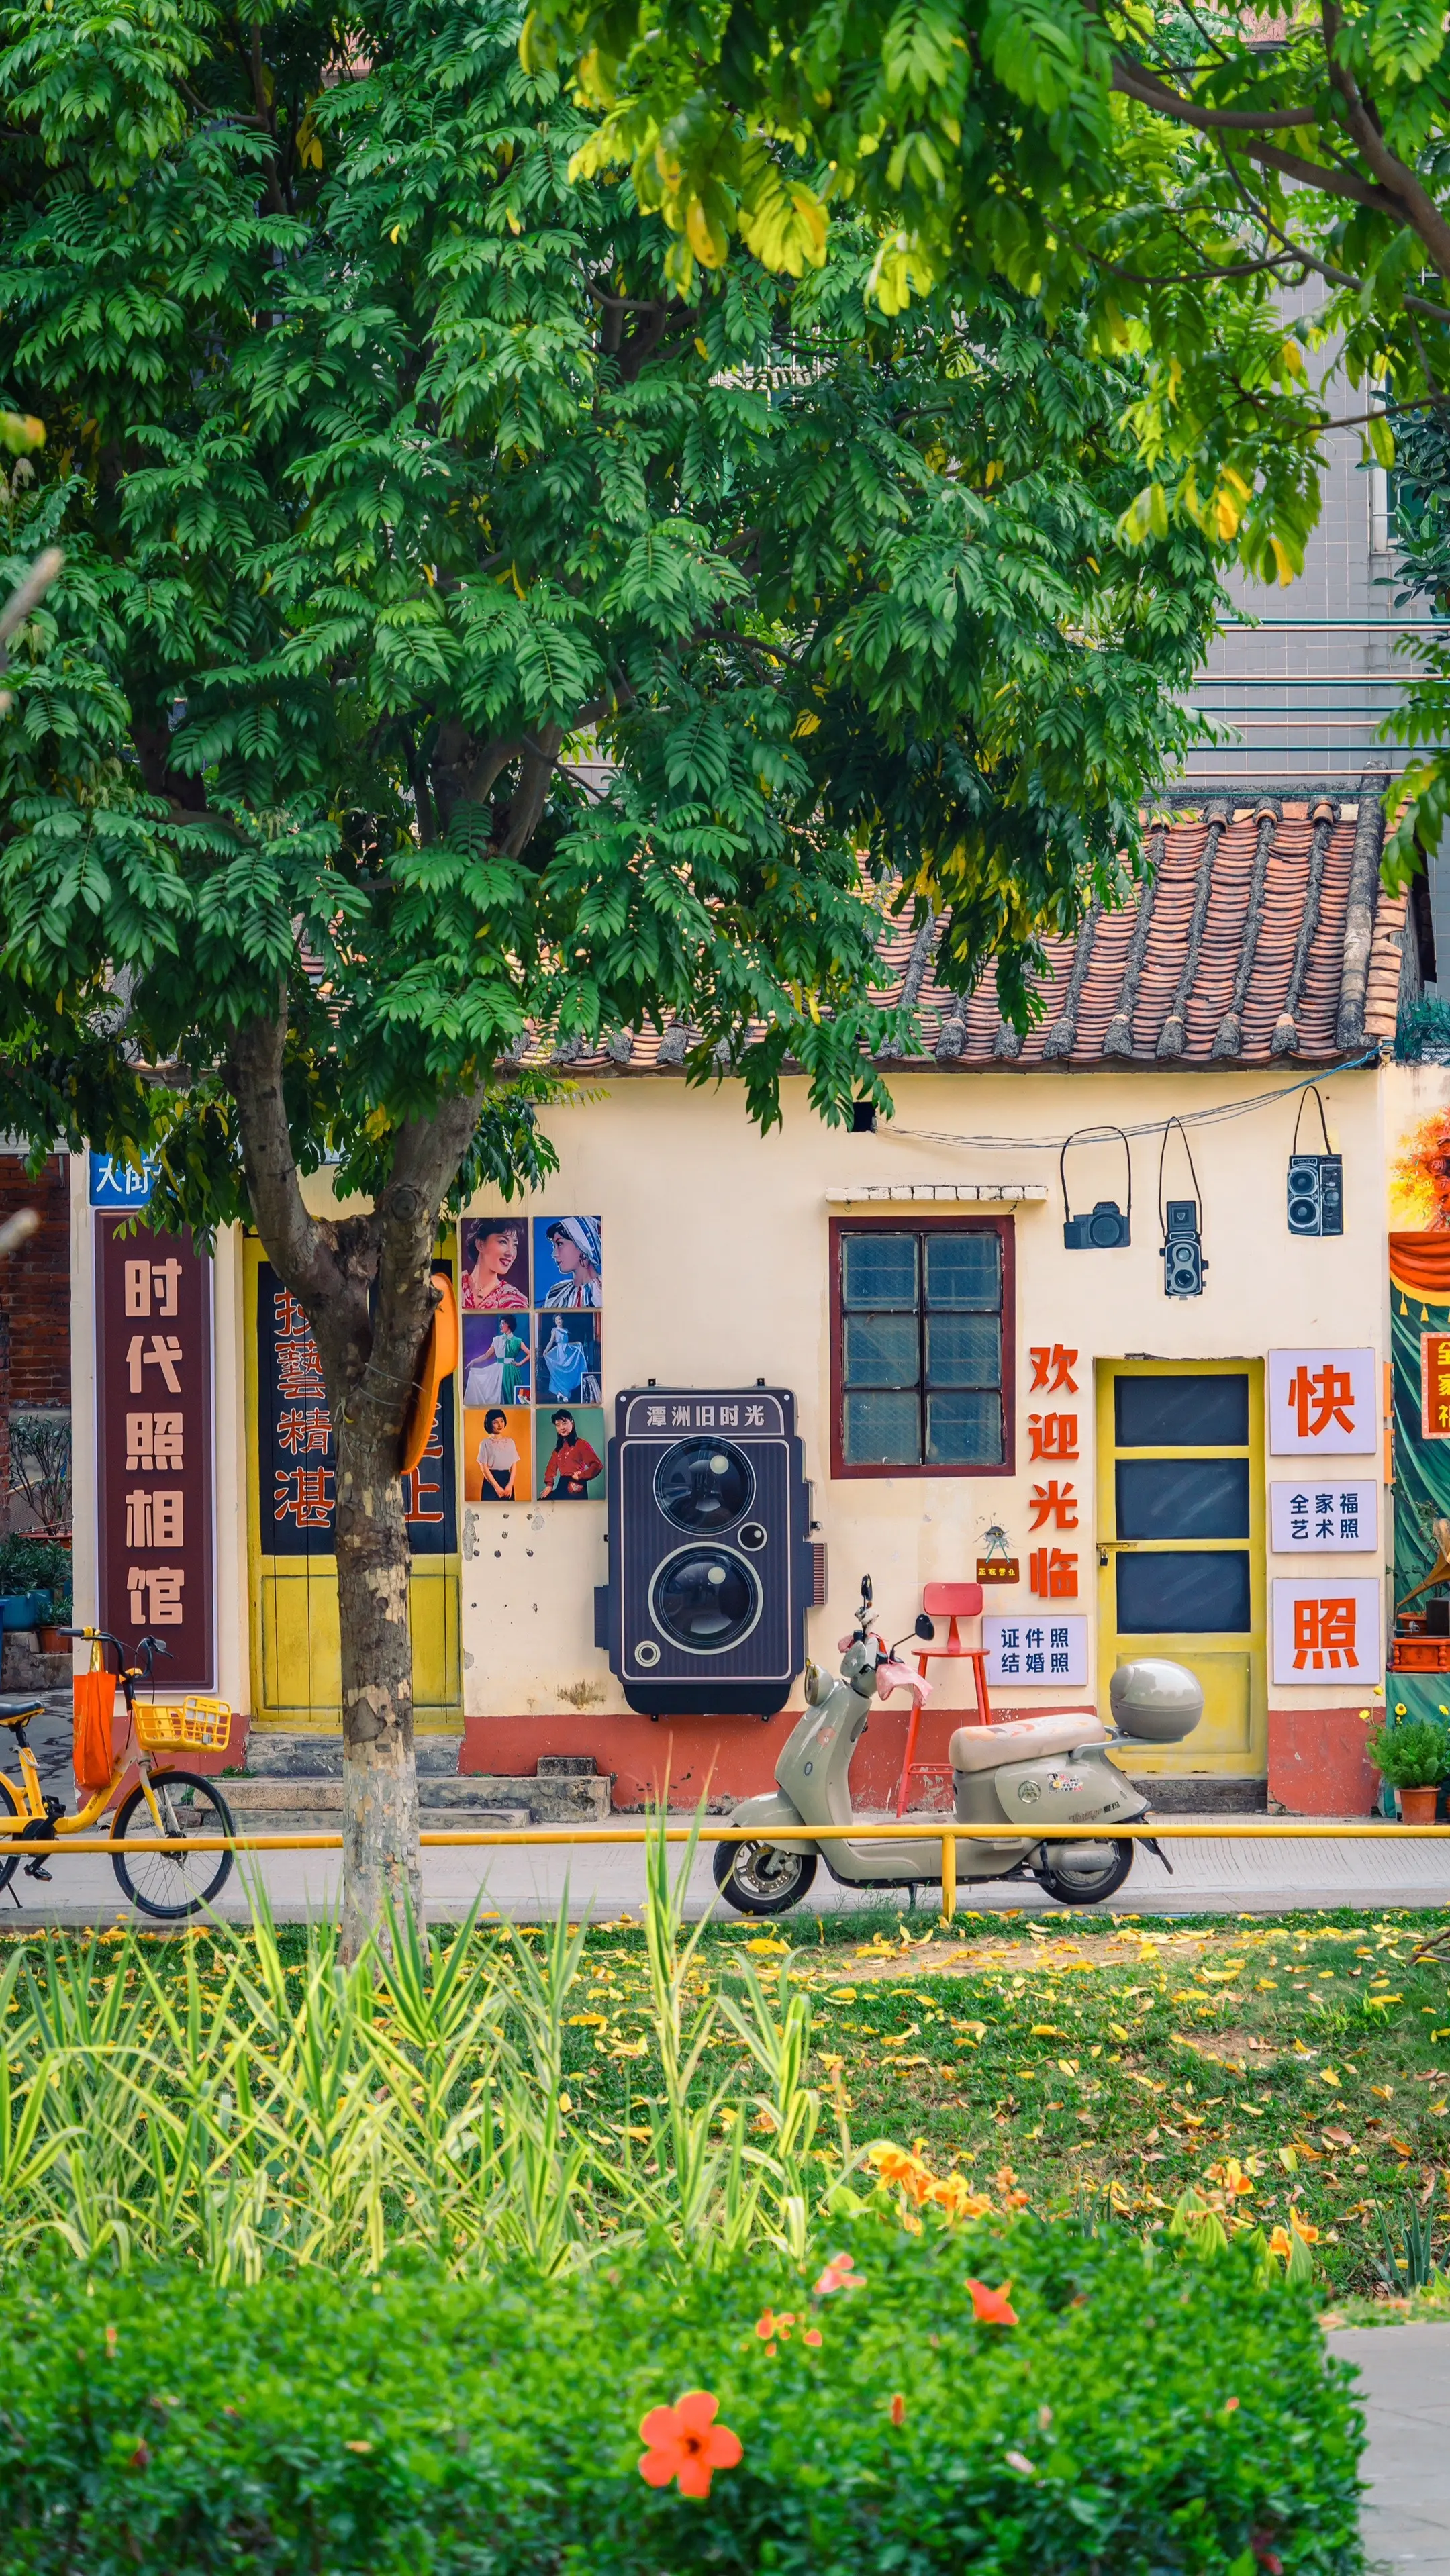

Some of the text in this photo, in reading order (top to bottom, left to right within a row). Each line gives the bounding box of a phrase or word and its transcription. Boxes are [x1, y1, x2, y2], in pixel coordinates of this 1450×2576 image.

[95, 1158, 164, 1195] 大街
[1288, 1365, 1355, 1437] 快
[646, 1405, 765, 1427] 潭洲旧时光
[124, 1258, 185, 1624] 时代照相馆
[1028, 1344, 1080, 1598] 欢迎光临
[1290, 1493, 1359, 1514] 全家福
[1290, 1518, 1359, 1540] 艺术照
[978, 1567, 1016, 1576] 正在营业
[1001, 1628, 1069, 1649] 证件照
[1294, 1598, 1359, 1669] 照
[1001, 1652, 1070, 1673] 结婚照
